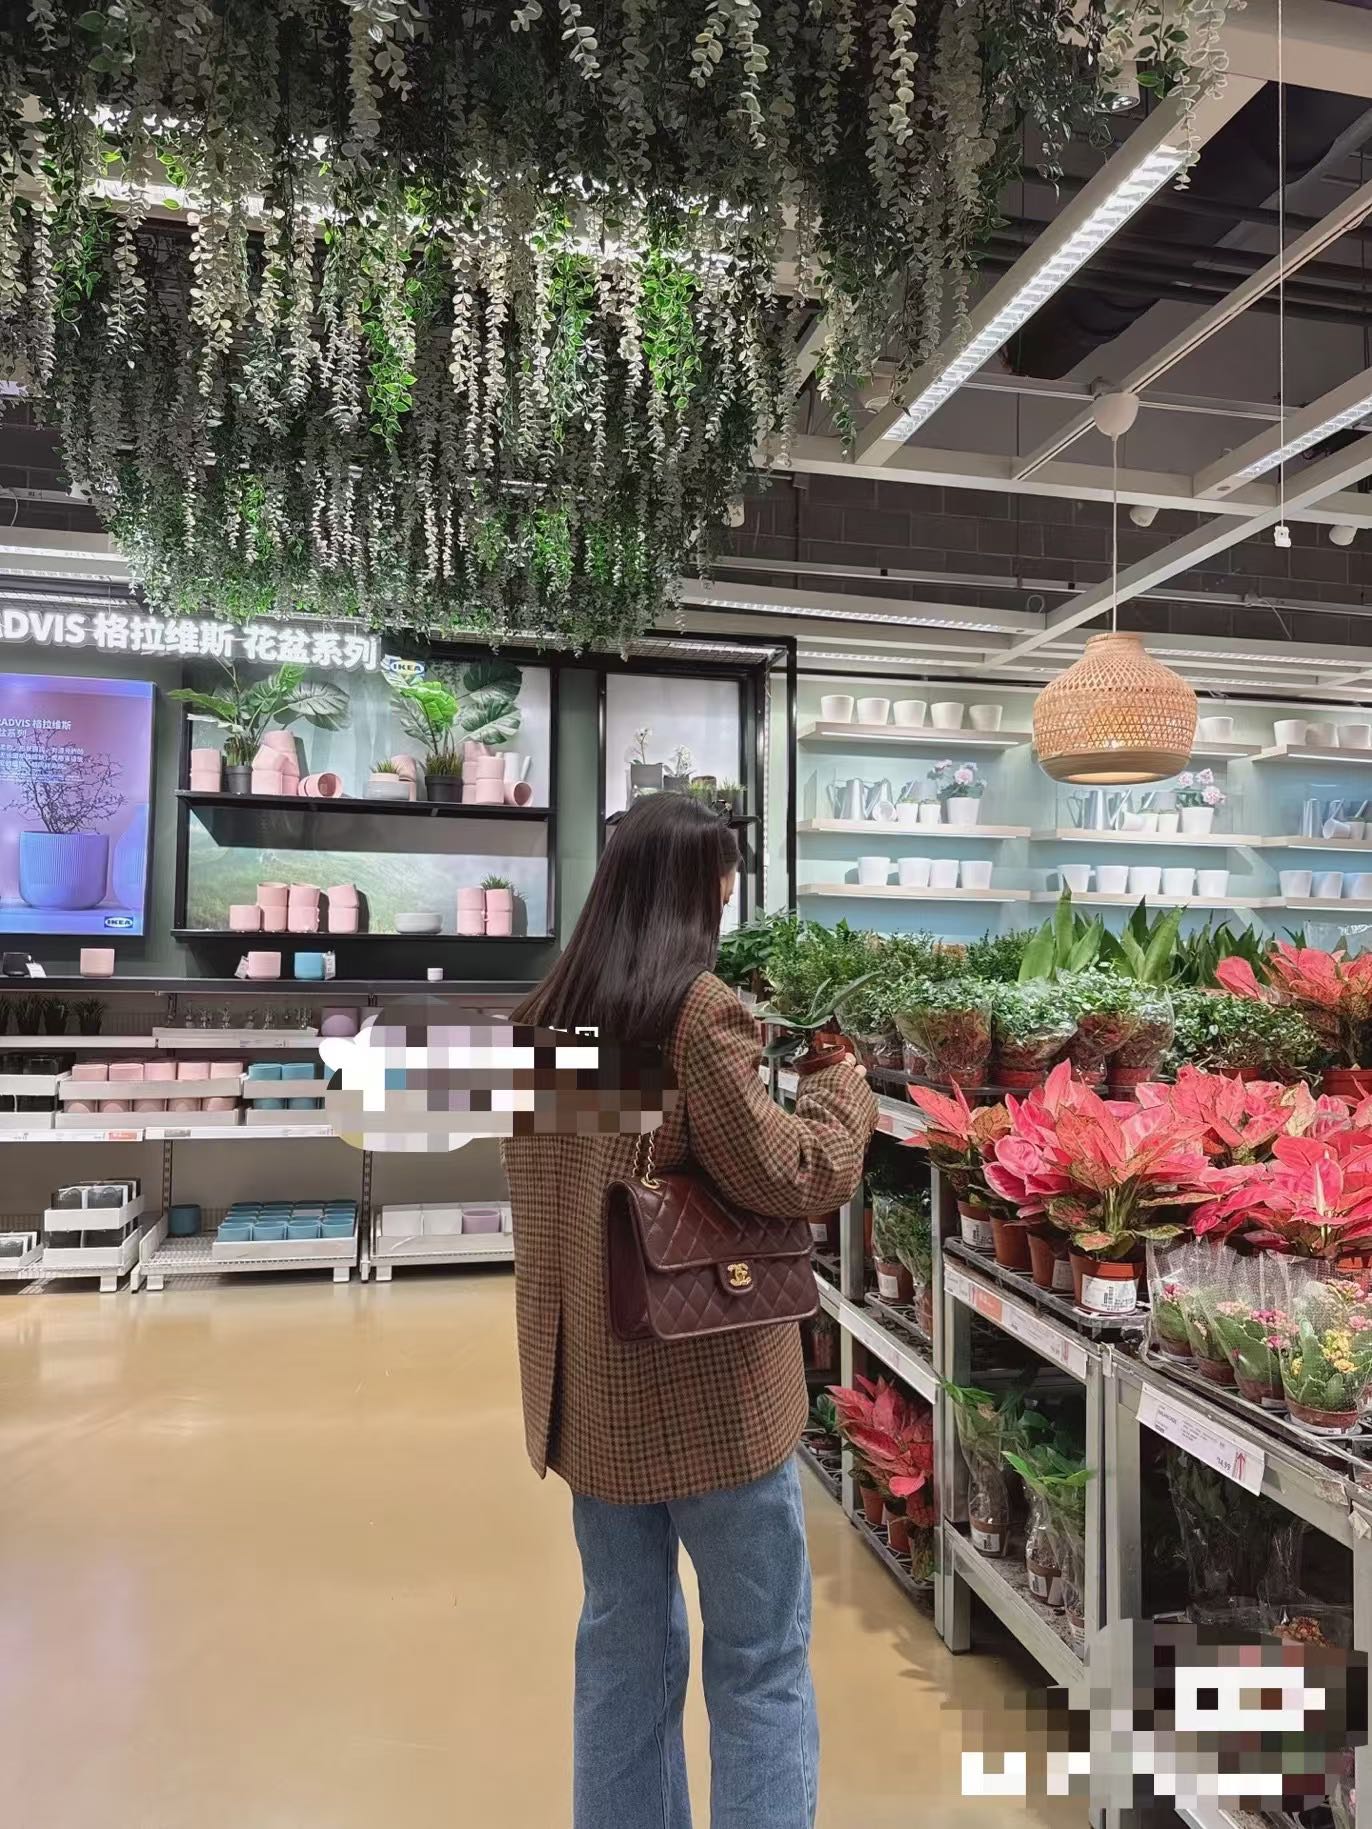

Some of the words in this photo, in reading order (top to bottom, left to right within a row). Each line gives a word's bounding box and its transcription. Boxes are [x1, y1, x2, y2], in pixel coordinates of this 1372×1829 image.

[0, 609, 85, 643] DVIS
[92, 612, 235, 657] 格拉维斯
[243, 624, 377, 670] 花盆系列
